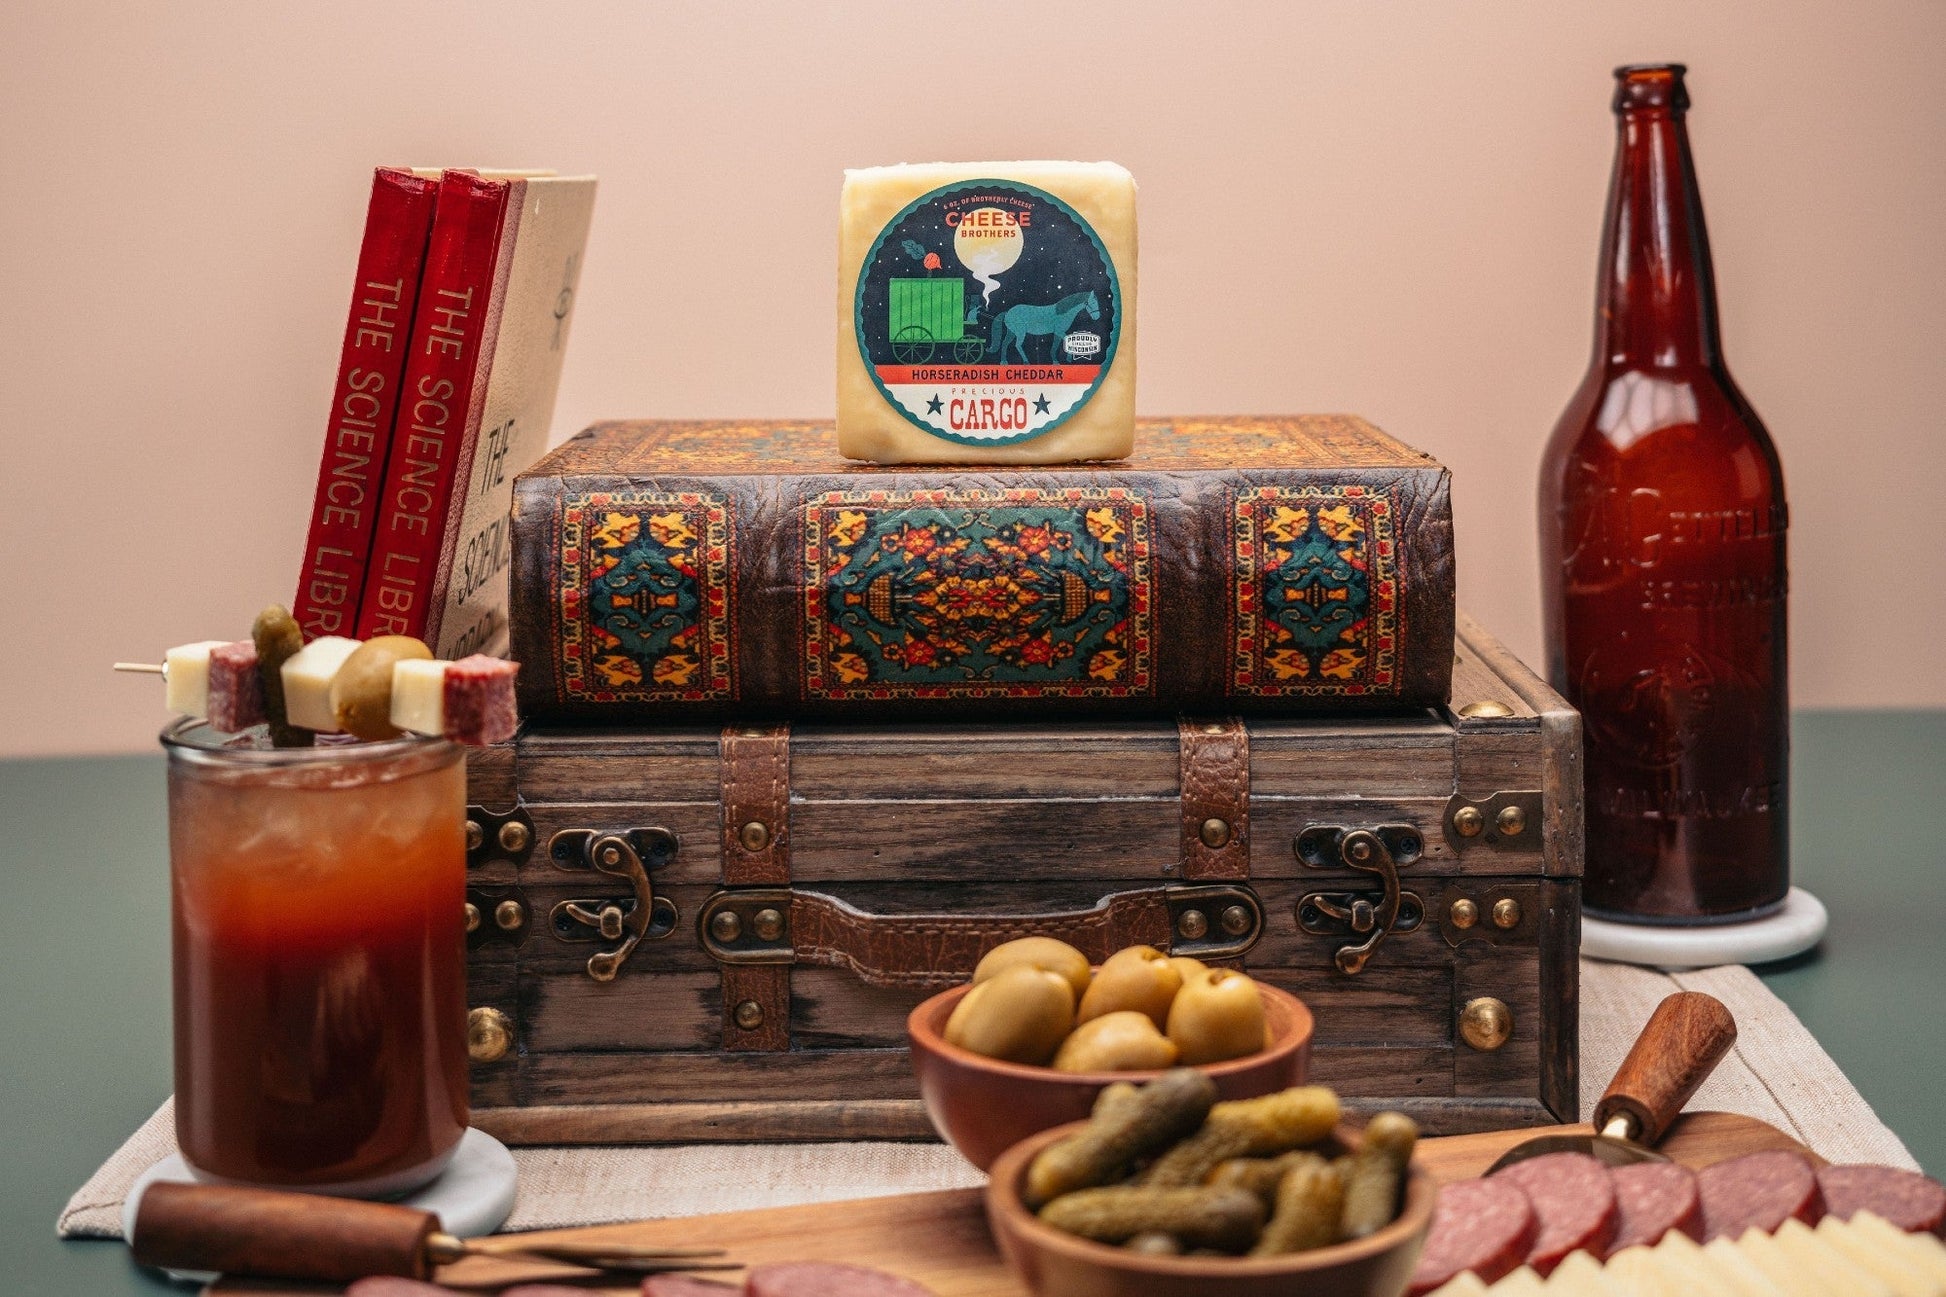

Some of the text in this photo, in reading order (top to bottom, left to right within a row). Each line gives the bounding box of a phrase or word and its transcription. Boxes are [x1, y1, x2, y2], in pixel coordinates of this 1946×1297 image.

[945, 211, 1031, 227] CHEESE
[961, 229, 1016, 238] BROTHERS
[355, 278, 403, 352] THE
[1067, 335, 1098, 343] PROUDLY
[912, 369, 1064, 380] HORSERADISH CHEDDAR
[951, 387, 1025, 395] PRECIOUS
[950, 397, 1028, 430] CARGO
[322, 367, 385, 529] SCIENCE
[480, 418, 516, 496] THE
[372, 286, 473, 636] THE SCIENCE LIBR
